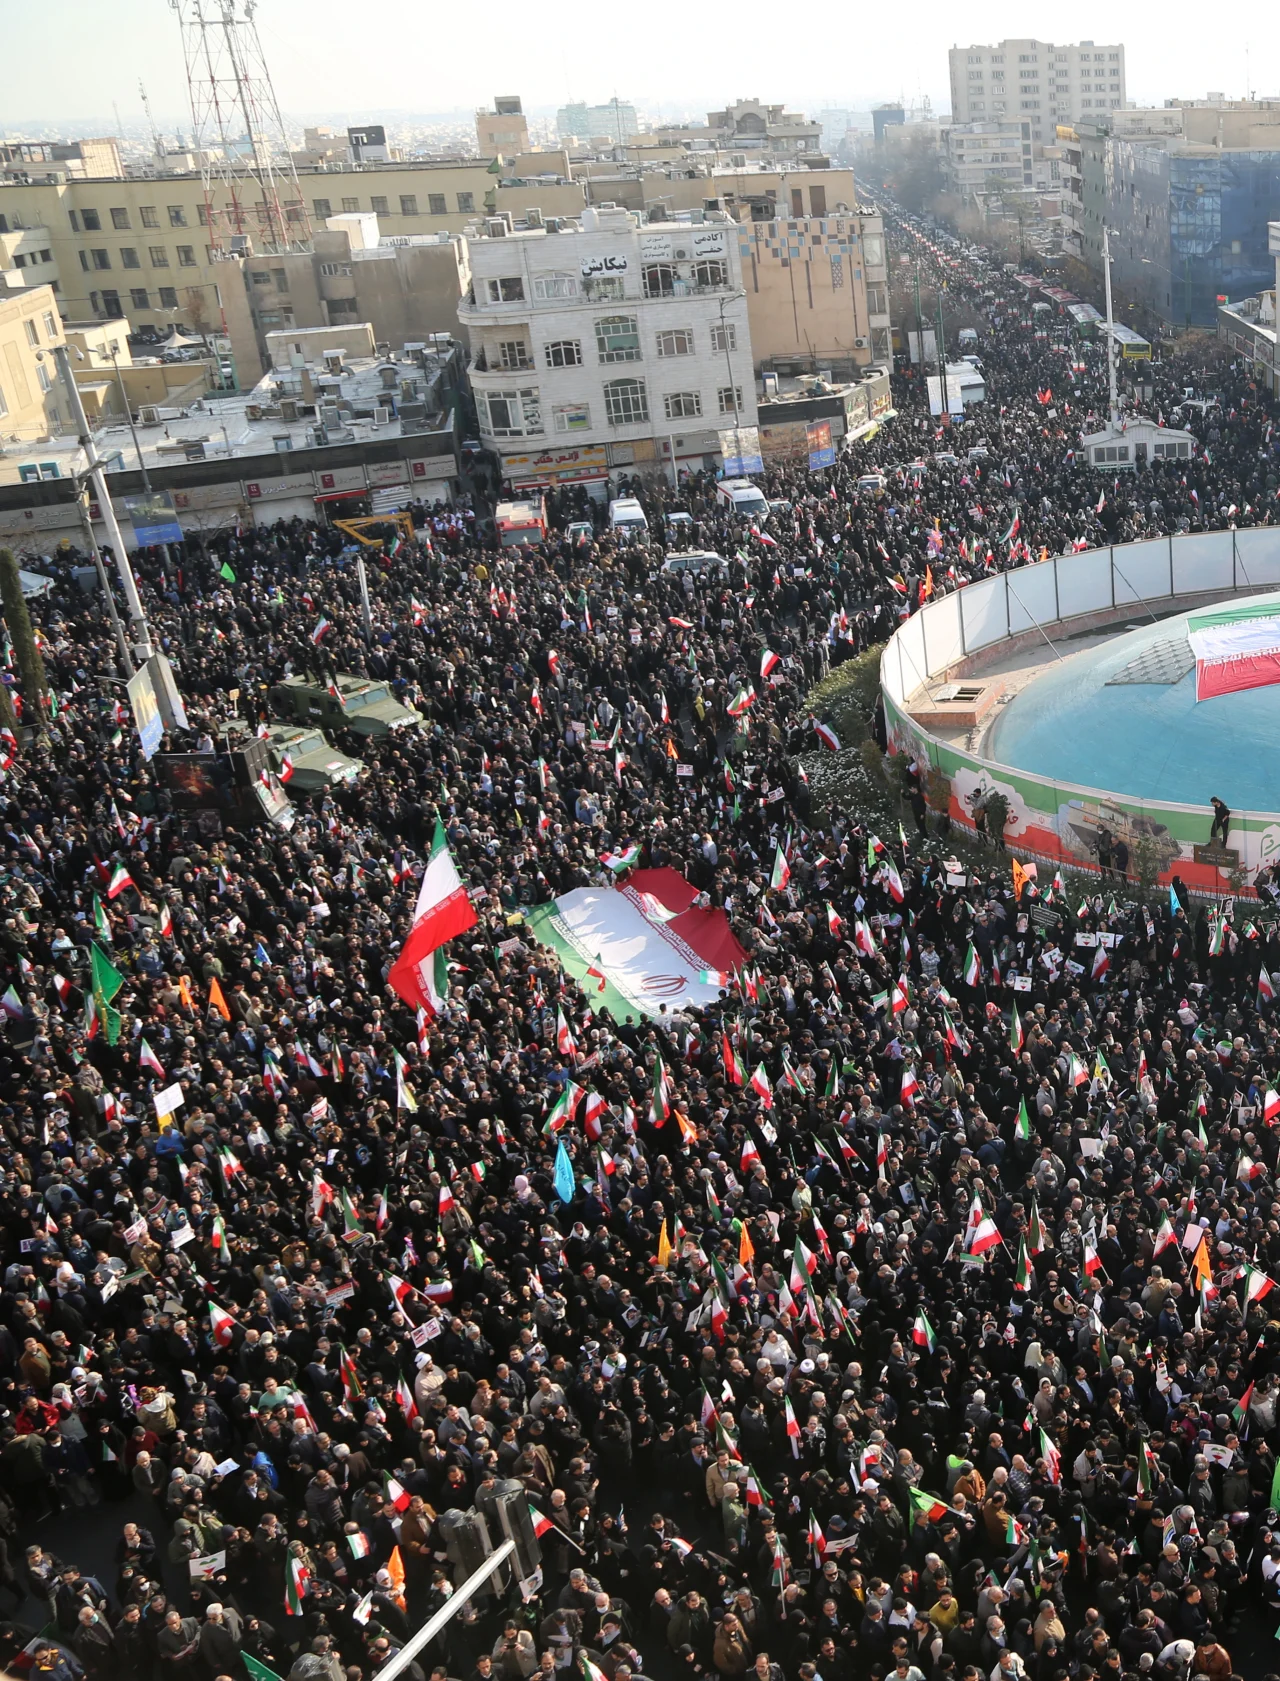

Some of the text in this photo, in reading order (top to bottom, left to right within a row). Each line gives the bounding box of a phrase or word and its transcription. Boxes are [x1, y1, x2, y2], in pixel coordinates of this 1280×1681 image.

[694, 232, 723, 245] آکادمی
[696, 247, 723, 256] حنفی
[581, 255, 627, 277] نیکایش
[533, 456, 554, 466] کتاب
[555, 450, 580, 464] آژانس
[308, 707, 323, 716] NOPO
[388, 716, 416, 729] NOPO
[332, 765, 359, 784] NOPO
